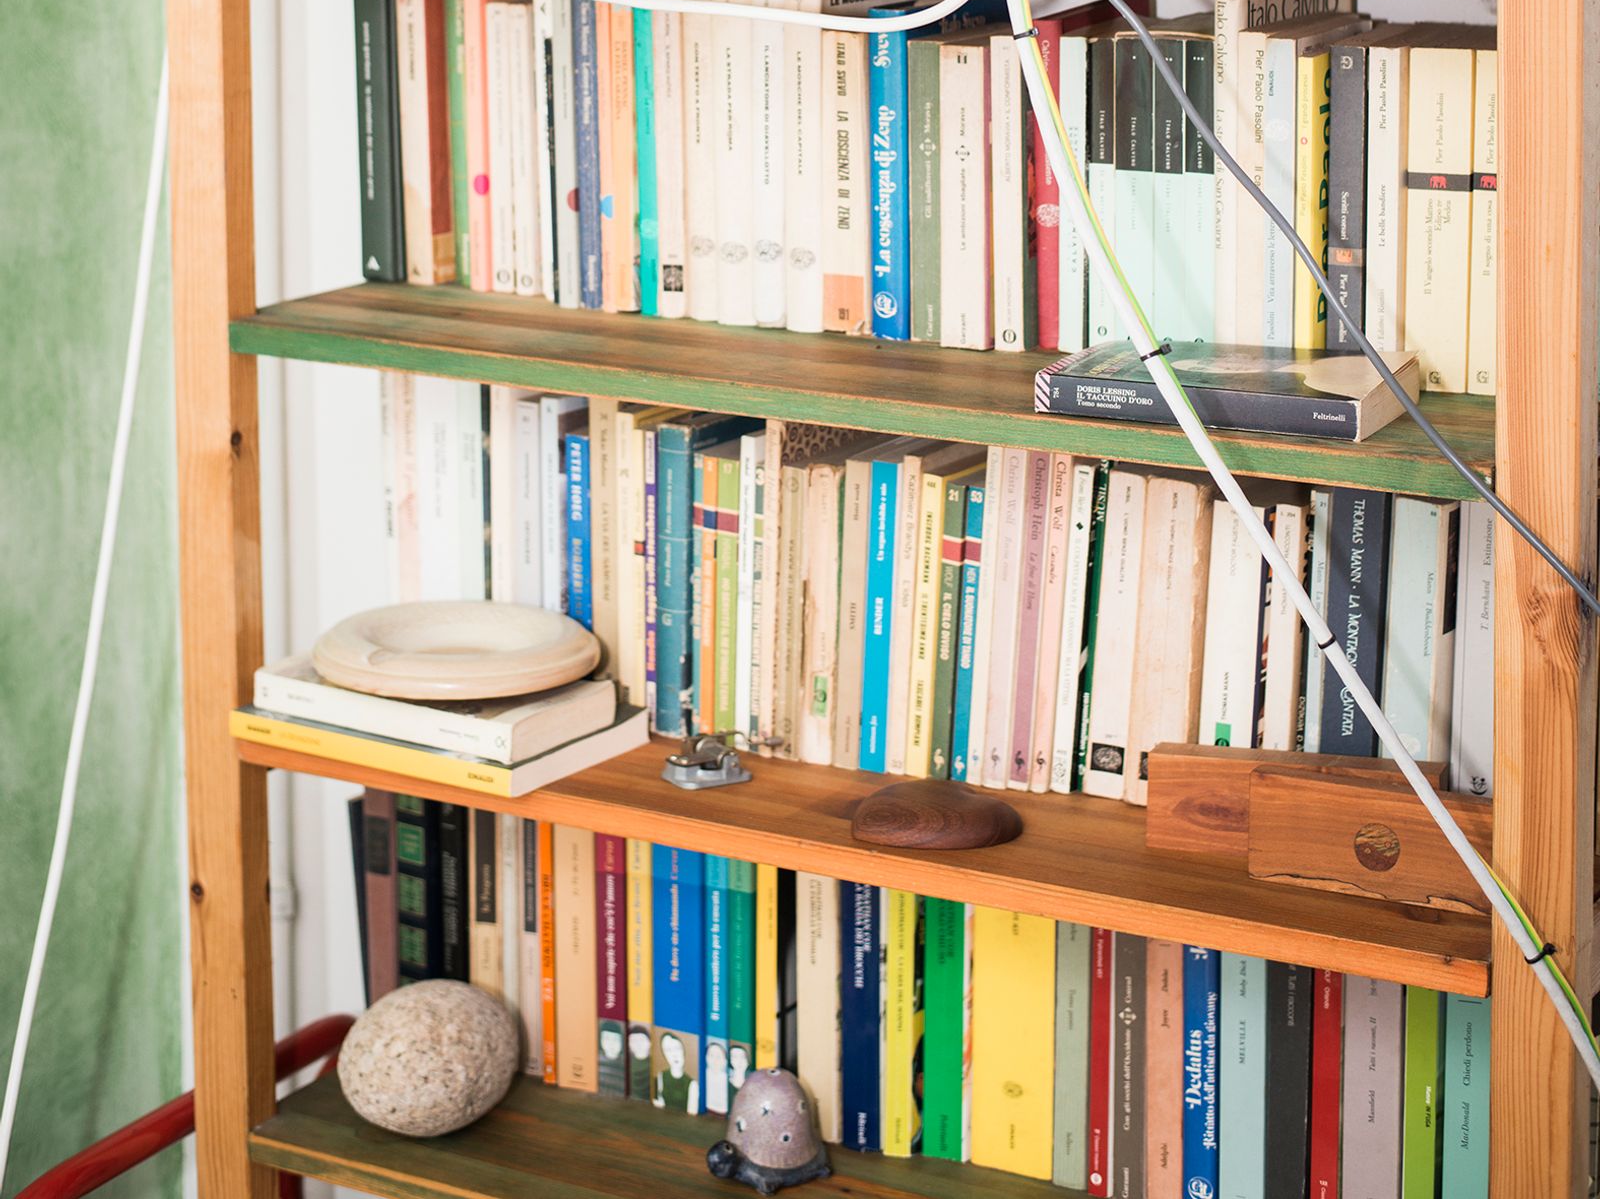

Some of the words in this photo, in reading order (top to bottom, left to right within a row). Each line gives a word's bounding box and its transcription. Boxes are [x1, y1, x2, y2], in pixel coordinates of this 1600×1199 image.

[1216, 1, 1228, 29] Italo
[1247, 0, 1278, 30] Italo
[836, 42, 846, 66] ITALO
[873, 32, 892, 69] Svev
[1215, 34, 1227, 84] Calvino
[1254, 49, 1264, 69] Pier
[836, 70, 846, 97] SVEVO
[1254, 73, 1264, 102] Paolo
[1378, 58, 1388, 89] Pasolini
[836, 110, 848, 122] LA
[1379, 90, 1388, 114] Paolo
[1436, 92, 1445, 122] Pasolini
[873, 104, 897, 148] Zeno
[1253, 104, 1265, 144] Pasolini
[1379, 115, 1388, 129] Pier
[1436, 124, 1445, 147] Paolo
[836, 130, 849, 181] COSCIENZA
[874, 150, 897, 168] di
[1098, 132, 1106, 160] CALVINO
[837, 188, 849, 199] DI
[1339, 191, 1349, 214] Scritti
[1378, 184, 1386, 217] bandiere
[837, 206, 850, 230] ZENO
[873, 170, 897, 250] coscienza
[1425, 198, 1434, 226] Matteo
[1339, 215, 1348, 240] corsari
[1378, 218, 1386, 237] belle
[1425, 227, 1434, 256] secondo
[875, 252, 892, 278] La
[1424, 257, 1435, 288] Vangelo
[1339, 274, 1349, 289] Pier
[1076, 392, 1084, 400] IL
[1086, 393, 1127, 404] TACCUINO
[1129, 396, 1153, 406] D'ORO
[1077, 385, 1101, 394] DORIS
[1103, 387, 1136, 396] LESSING
[1076, 400, 1094, 408] Tomo
[1096, 401, 1122, 410] secondo
[1312, 411, 1346, 422] Feltrinelli
[570, 442, 582, 482] PETER
[1031, 458, 1047, 511] Christoph
[1054, 461, 1067, 497] Christa
[905, 474, 917, 520] Kazimierz
[1096, 483, 1107, 522] MUSIL
[1031, 514, 1044, 541] Hein
[1052, 505, 1064, 530] Wolf
[1351, 499, 1366, 544] THOMAS
[903, 522, 914, 560] Brandys
[1482, 518, 1493, 566] Estinzione
[1349, 548, 1365, 584] MANN
[1348, 594, 1361, 608] LA
[1480, 580, 1490, 621] Bernhard
[873, 596, 884, 636] BENDER
[942, 601, 952, 629] CIELO
[940, 630, 951, 661] DIVISO
[1345, 613, 1362, 668] MONTAGN
[1124, 976, 1132, 1004] Conrad
[1239, 980, 1247, 998] Moby
[1161, 1009, 1170, 1029] Joyce
[1203, 991, 1217, 1033] giovane
[1203, 1034, 1215, 1049] da
[1463, 1022, 1473, 1058] perdono
[1185, 1029, 1202, 1110] Dedalus
[1202, 1050, 1216, 1104] dell'artista
[1462, 1059, 1472, 1087] Chiedi
[1460, 1101, 1470, 1150] MacDonald
[1160, 1143, 1168, 1169] Adelphi
